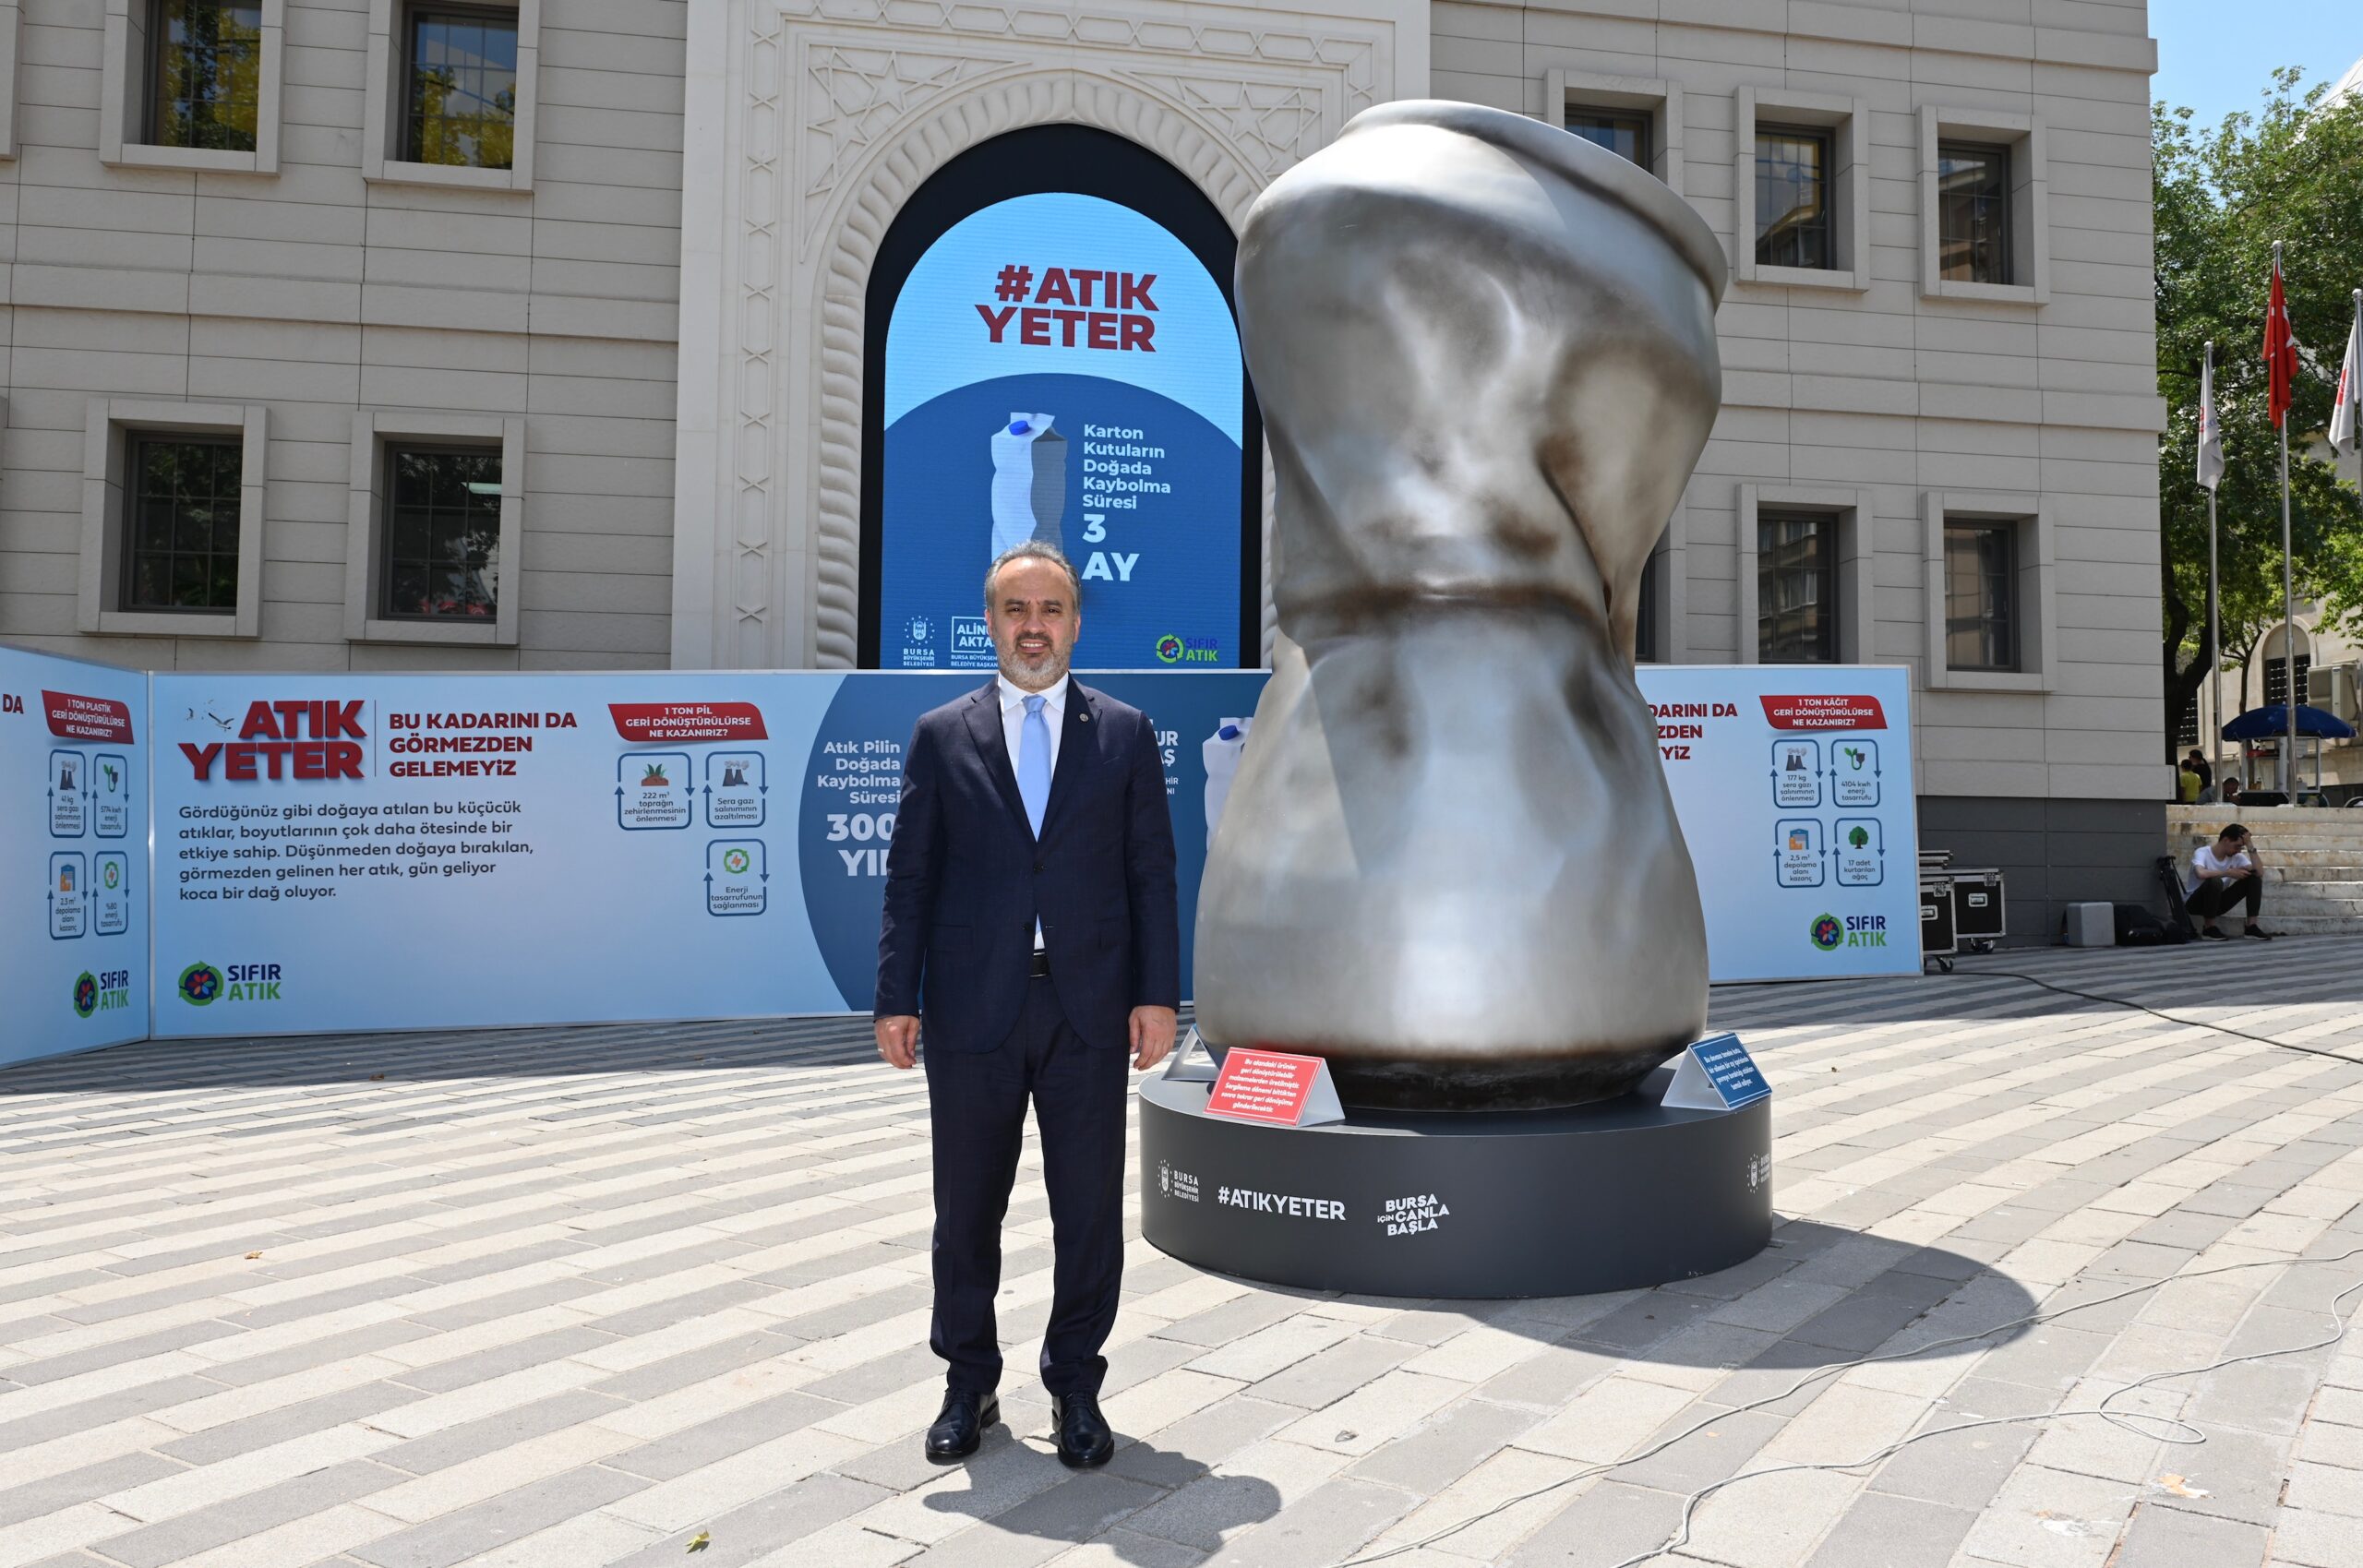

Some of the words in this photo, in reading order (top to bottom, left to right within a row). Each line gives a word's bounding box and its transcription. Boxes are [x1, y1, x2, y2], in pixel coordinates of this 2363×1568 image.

[994, 264, 1160, 312] #ATIK
[975, 304, 1157, 353] YETER
[1084, 424, 1144, 440] Karton
[1084, 441, 1165, 459] Kutuların
[1084, 459, 1152, 476] Doğada
[1083, 476, 1171, 494] Kaybolma
[1083, 494, 1137, 509] Süresi
[1082, 513, 1107, 543] 3
[1081, 551, 1141, 581] AY
[956, 622, 990, 635] ALİN
[958, 636, 995, 648] AKTA
[1185, 638, 1217, 649] SIFIR
[903, 648, 935, 656] BURSA
[1185, 649, 1218, 662] ATIK
[3, 693, 24, 714] DA
[67, 699, 72, 708] 1
[72, 700, 86, 710] TON
[86, 700, 112, 713] PLASTİK
[665, 707, 669, 715] 1
[671, 707, 694, 715] TON
[697, 705, 713, 715] PİL
[1648, 703, 1708, 718] DARINI
[1712, 703, 1738, 717] DA
[1804, 699, 1822, 707] TON
[52, 709, 68, 721] GERİ
[68, 711, 126, 727] DÖNÜŞTÜRÜLÜRSE
[238, 700, 367, 739] ATIK
[1773, 707, 1793, 716] GERİ
[1795, 707, 1874, 717] DÖNÜŞTÜRÜLÜRSE
[390, 713, 420, 729] BU
[426, 712, 539, 729] KADARINI
[546, 712, 578, 728] DA
[626, 716, 651, 727] GERİ
[653, 716, 751, 728] DÖNÜŞTÜRÜLÜRSE
[1793, 718, 1805, 726] NE
[1806, 718, 1855, 726] KAZANIRIZ?
[66, 724, 76, 734] NE
[77, 725, 113, 737] KAZANIRIZ?
[649, 729, 664, 737] NE
[666, 728, 728, 737] KAZANIRIZ?
[390, 732, 533, 753] GÖRMEZDEN
[823, 741, 859, 754] Atık
[864, 740, 901, 754] Pilin
[177, 741, 366, 781] YETER
[835, 758, 901, 773] Doğada
[818, 774, 901, 790] Kaybolma
[849, 790, 901, 804] Süresi
[1847, 787, 1865, 796] enerji
[179, 805, 279, 821] Gördüğünüz
[282, 804, 313, 820] gibi
[317, 803, 378, 819] doğaya
[383, 802, 429, 815] atılan
[434, 801, 453, 814] bu
[458, 800, 522, 817] küçücük
[639, 799, 674, 808] toprağın
[717, 797, 736, 806] Sera
[738, 798, 754, 808] gazı
[624, 807, 687, 816] zehirlenmesinin
[636, 814, 677, 822] önlenmesi
[179, 826, 235, 841] atıklar,
[240, 824, 338, 841] boyutlarının
[342, 822, 370, 839] çok
[374, 822, 415, 835] daha
[420, 820, 487, 835] ötesinde
[492, 820, 513, 833] bir
[826, 813, 897, 842] 300
[179, 846, 229, 862] etkiye
[233, 844, 281, 860] sahip.
[286, 843, 391, 860] Düşünmeden
[395, 842, 456, 857] doğaya
[461, 841, 534, 855] bırakılan,
[179, 867, 271, 883] görmezden
[276, 865, 334, 880] gelinen
[339, 864, 365, 877] her
[368, 863, 403, 877] atık,
[408, 862, 438, 878] gün
[443, 861, 497, 877] geliyor
[1784, 861, 1817, 869] depolama
[180, 887, 218, 901] koca
[222, 887, 245, 899] bir
[248, 885, 280, 901] dağ
[284, 885, 337, 902] oluyor.
[711, 892, 763, 902] tasarrufunun
[726, 886, 749, 896] Enerji
[1846, 916, 1886, 930] SIFIR
[1847, 930, 1888, 947] ATIK
[101, 970, 128, 990] SIFIR
[227, 964, 282, 982] SIFIR
[228, 981, 282, 1001] ATIK
[101, 988, 129, 1011] ATIK
[1174, 1169, 1199, 1187] BURSA
[1217, 1186, 1347, 1221] #ATIKYETER
[1385, 1193, 1438, 1212] BURSA
[1395, 1203, 1450, 1223] CANLA
[1387, 1217, 1438, 1236] BAŞLA
